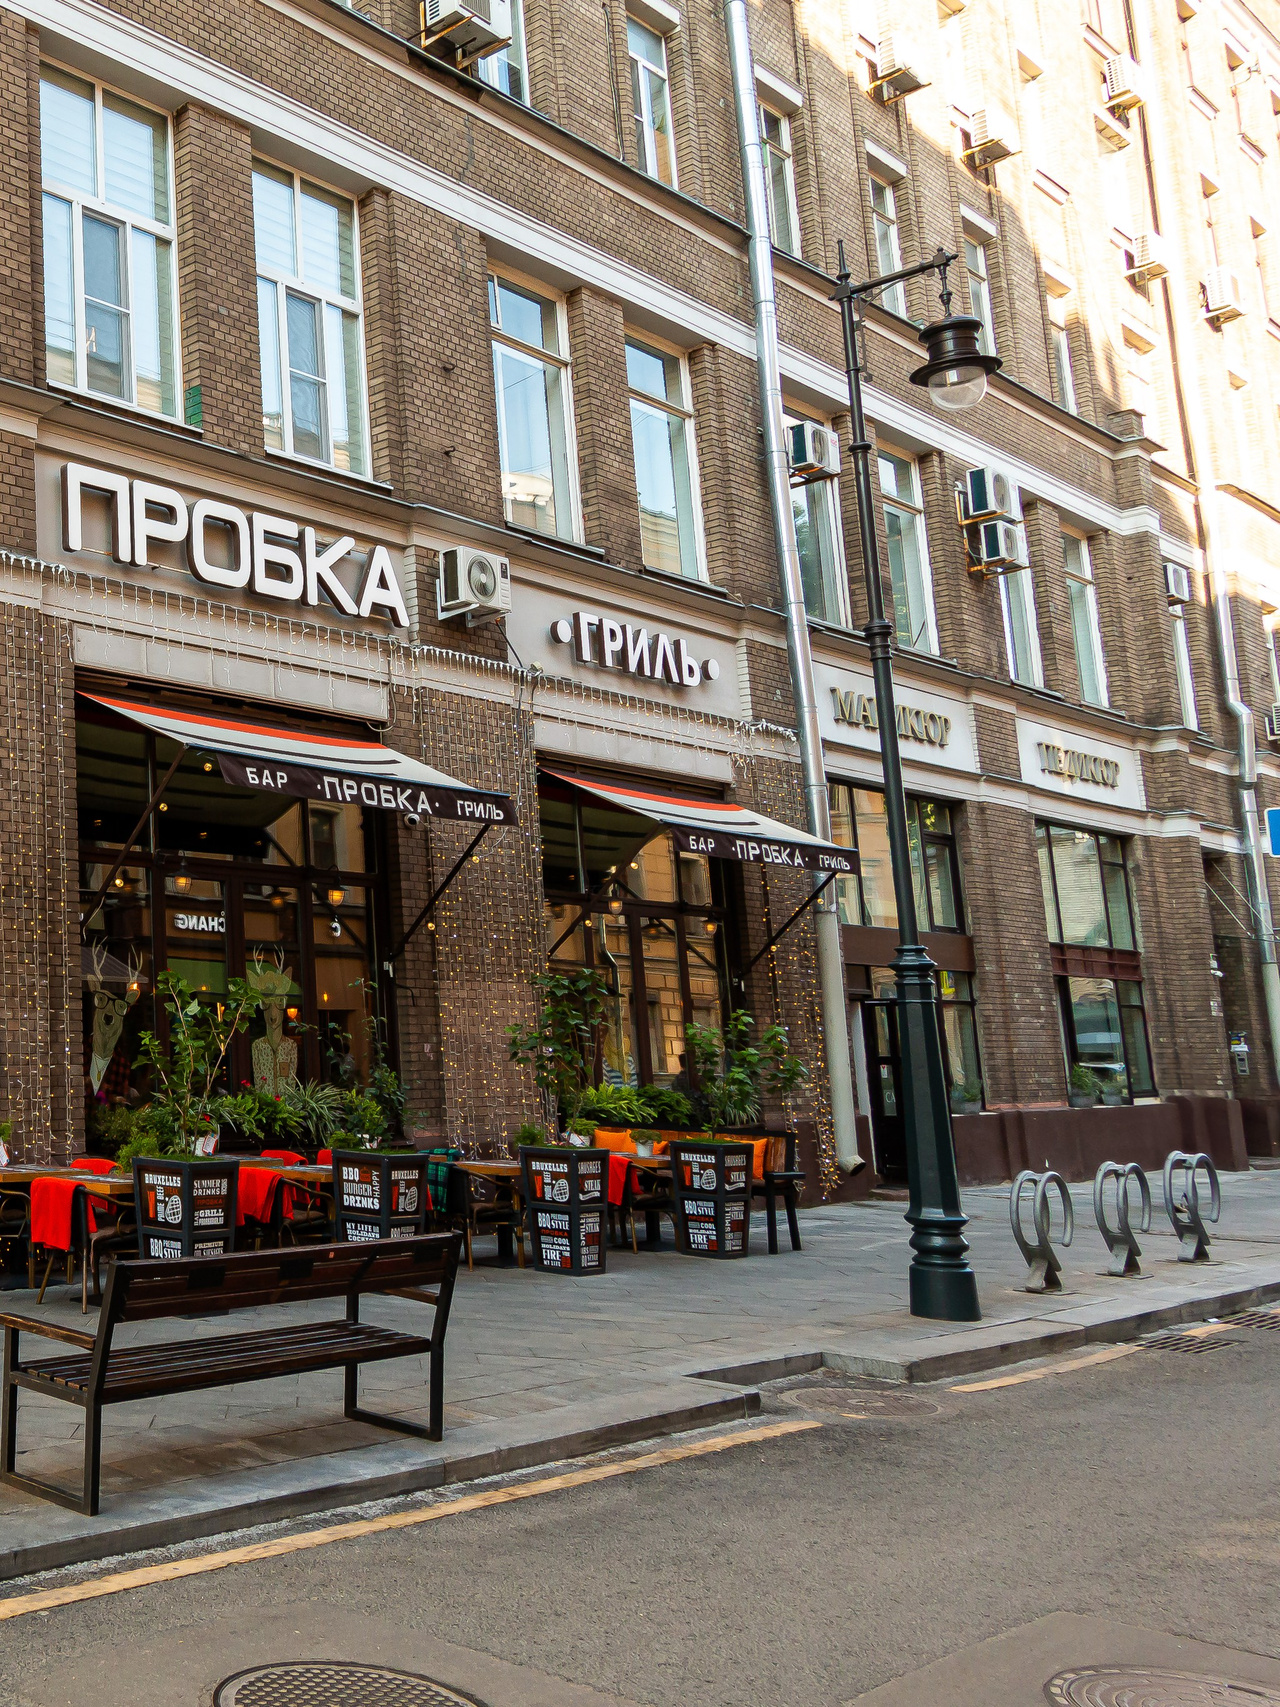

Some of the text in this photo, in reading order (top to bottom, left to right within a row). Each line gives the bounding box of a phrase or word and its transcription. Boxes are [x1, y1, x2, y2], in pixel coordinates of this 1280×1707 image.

[60, 461, 410, 628] ПРОБКА
[572, 611, 701, 687] ГРИЛЬ
[830, 686, 951, 747] МАИКЮР
[1037, 741, 1120, 789] ПЕДИКЮР
[246, 766, 505, 821] БАР ПРОБКА ГРИЛЬ
[689, 835, 851, 870] БАР ПРОБКА ГРИЛЬ
[681, 1152, 716, 1164] BRUXELLES
[532, 1161, 568, 1173] BRUXELLES
[144, 1173, 181, 1187] BRUXELLES
[342, 1166, 360, 1182] BBQ
[391, 1170, 419, 1180] BRUXELLES
[193, 1179, 221, 1188] SUMMER
[343, 1181, 373, 1197] BURGER
[372, 1170, 381, 1198] HAPPY
[584, 1180, 601, 1191] STEAK
[192, 1188, 221, 1196] DRINKS
[343, 1195, 380, 1210] DRINKS
[684, 1200, 697, 1216] BBQ
[199, 1208, 224, 1218] GRILL
[697, 1206, 715, 1216] STYLE
[346, 1222, 356, 1230] MY
[357, 1223, 373, 1232] LIFE
[538, 1212, 551, 1230] BBQ
[551, 1219, 570, 1230] STYLE
[700, 1222, 716, 1230] COOL
[553, 1237, 570, 1246] COOL
[690, 1233, 708, 1244] FIRE
[150, 1238, 163, 1258] BBQ
[542, 1249, 561, 1261] FIRE
